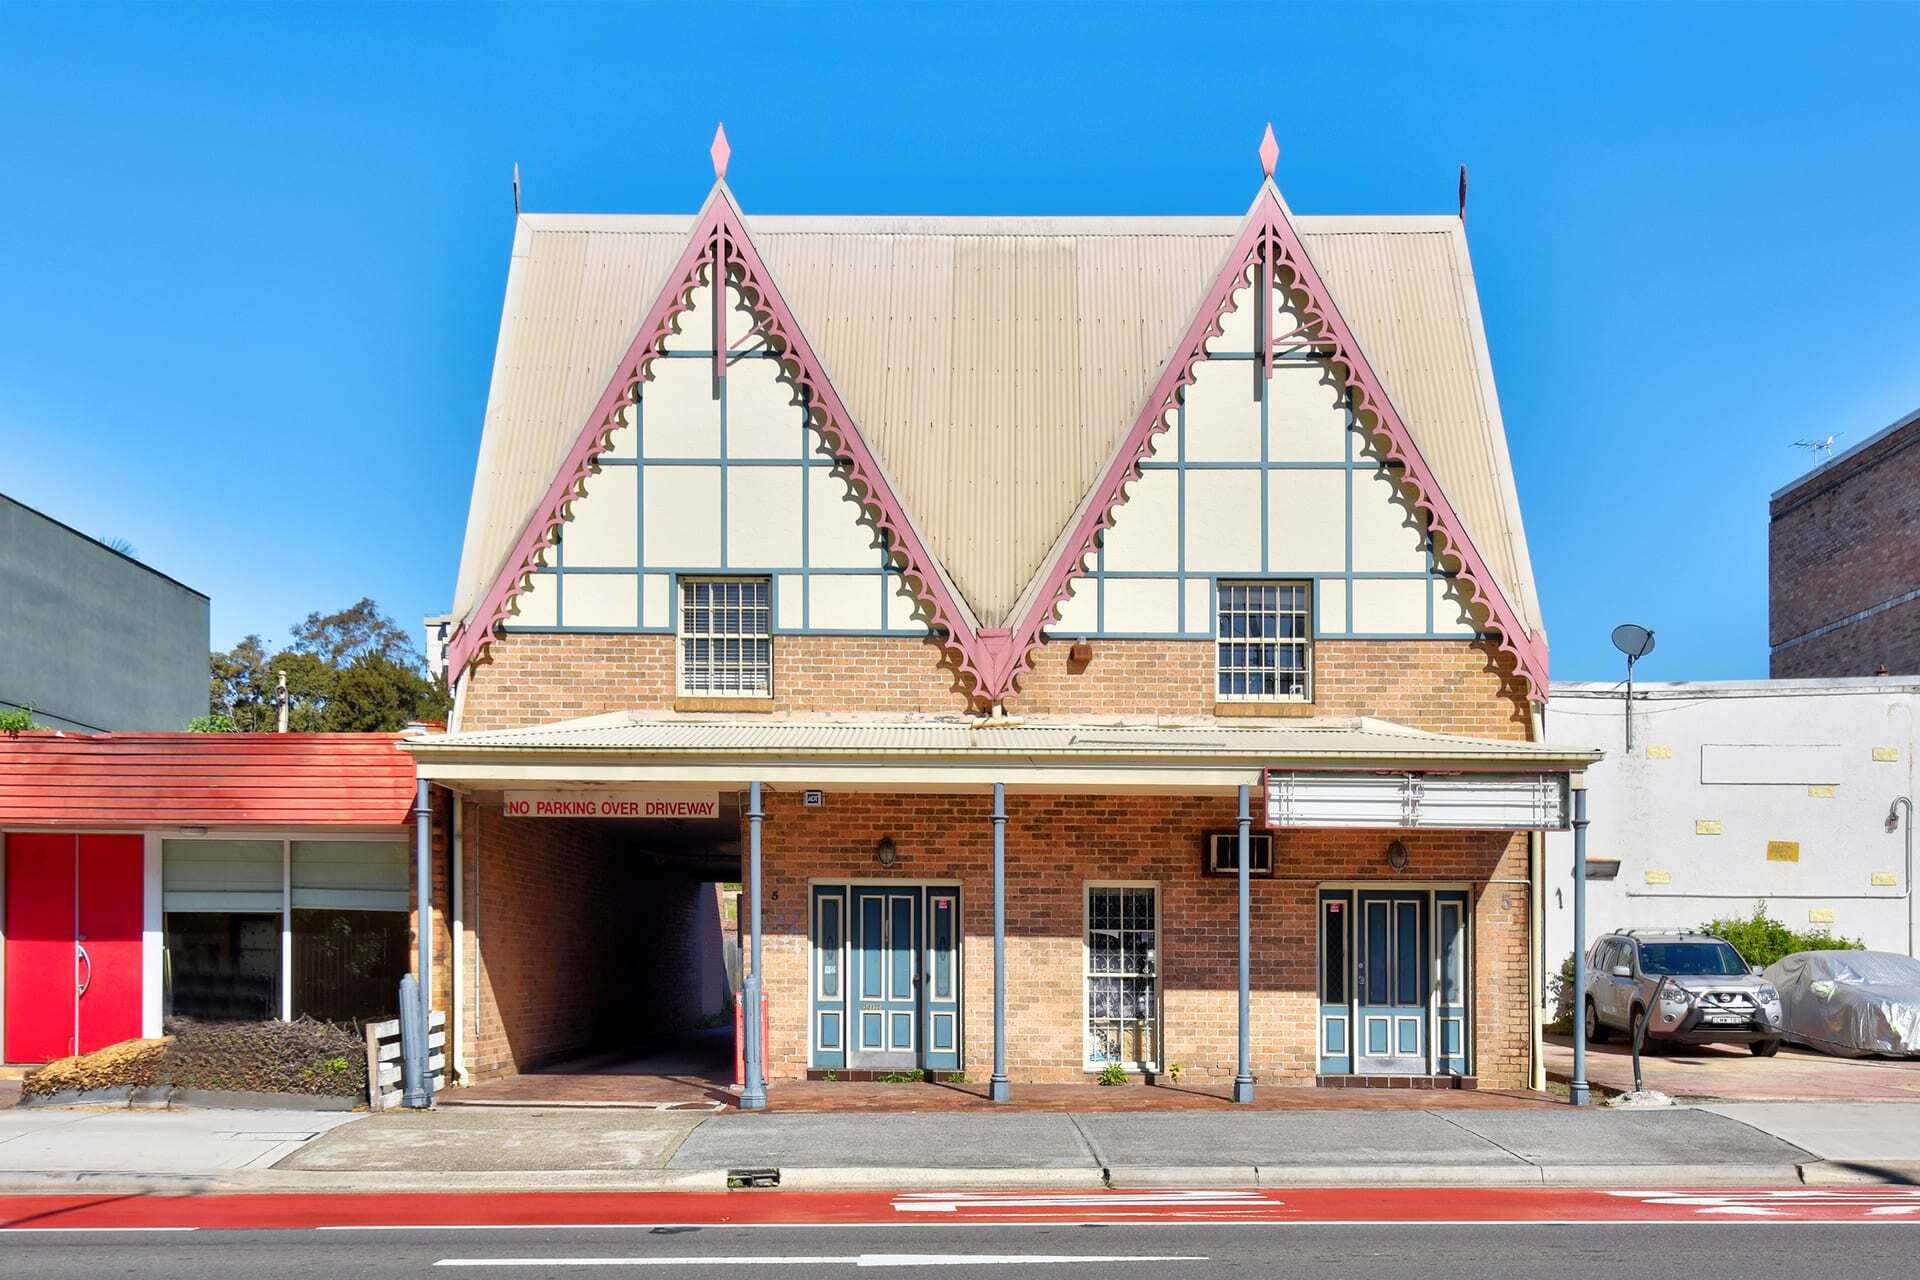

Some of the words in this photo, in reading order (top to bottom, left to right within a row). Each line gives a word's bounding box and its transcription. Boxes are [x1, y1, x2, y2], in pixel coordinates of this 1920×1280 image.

[508, 801, 529, 815] NO
[537, 801, 596, 815] PARKING
[601, 801, 639, 815] OVER
[645, 801, 714, 815] DRIVEWAY
